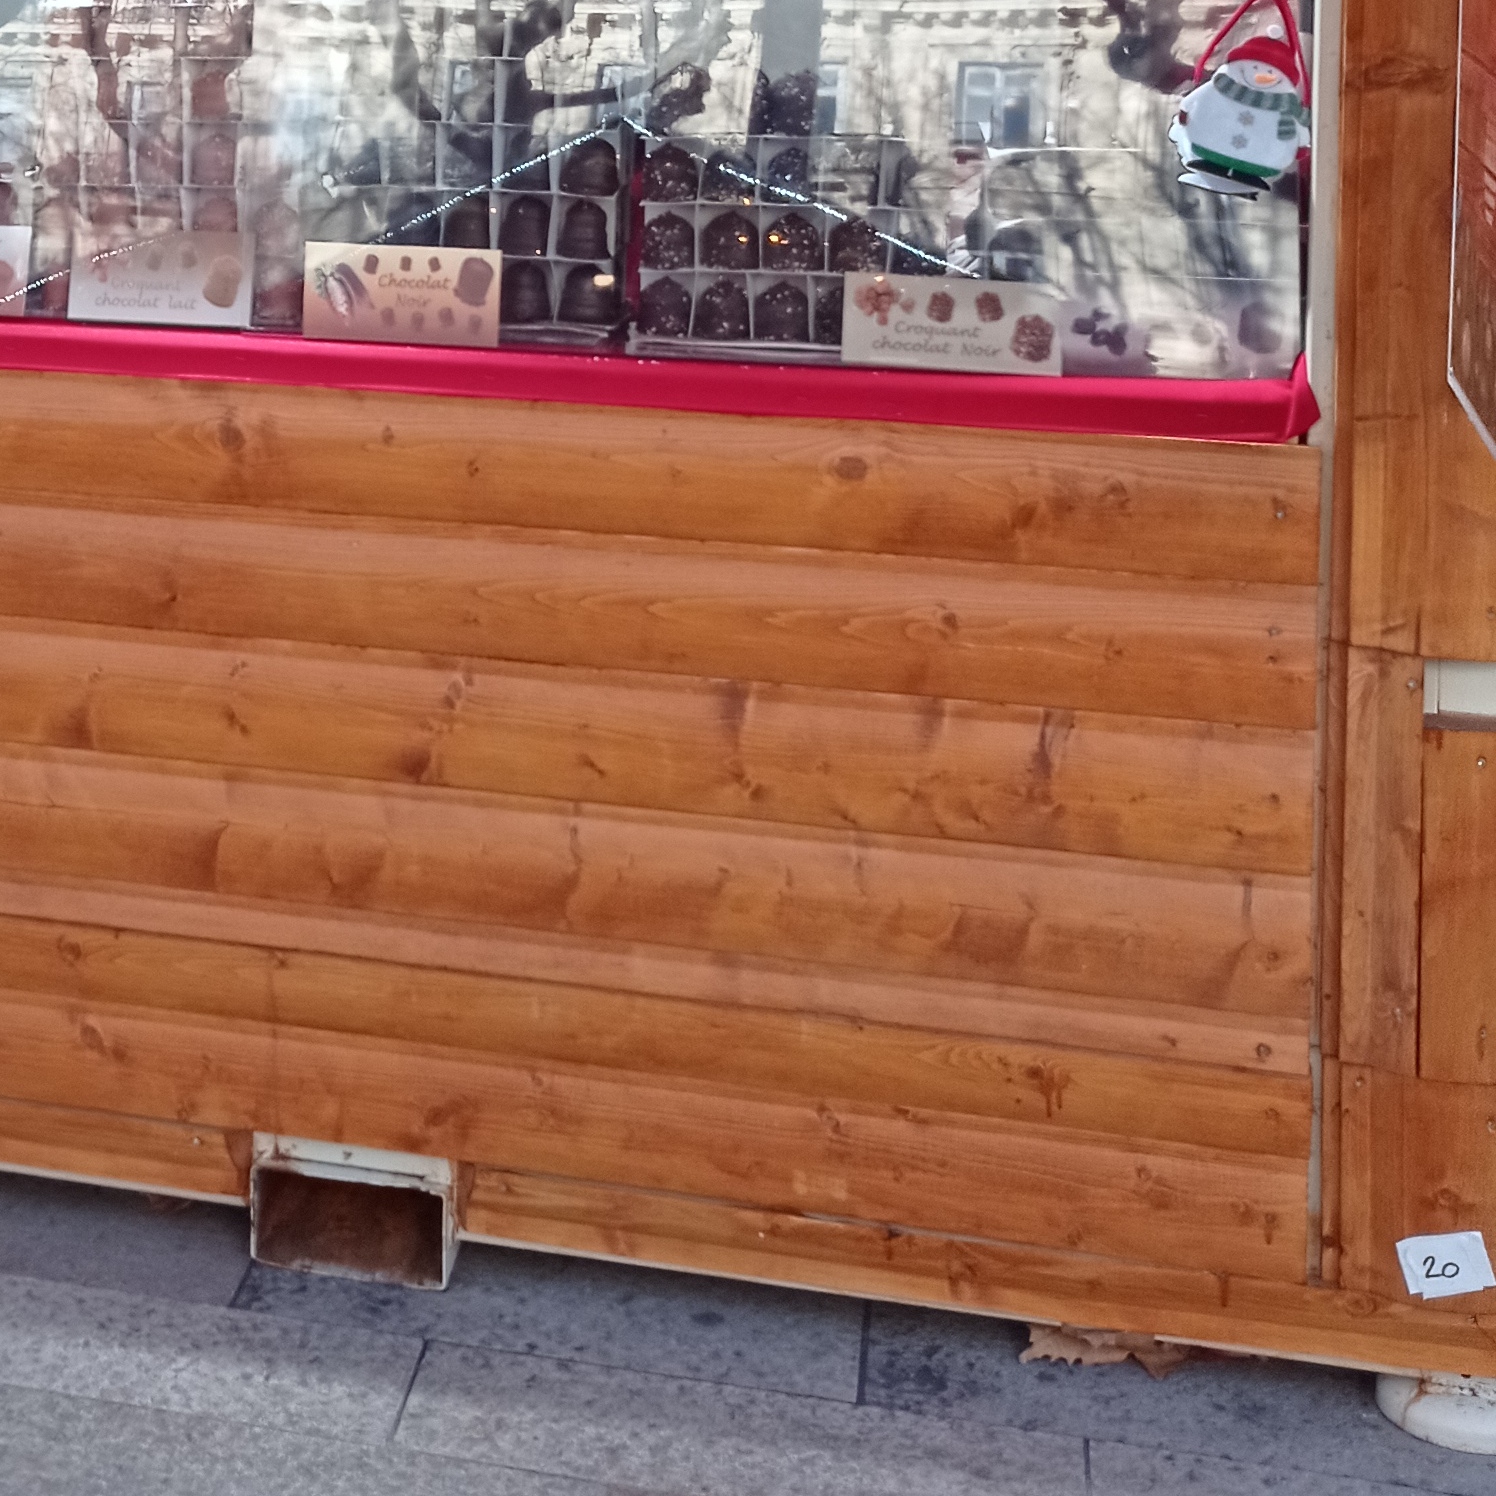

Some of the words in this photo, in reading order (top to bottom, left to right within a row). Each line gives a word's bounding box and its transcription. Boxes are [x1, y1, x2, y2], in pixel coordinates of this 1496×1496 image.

[377, 272, 452, 290] Chocolat
[894, 320, 982, 346] Croquant
[871, 335, 953, 354] chocolat
[1422, 1255, 1460, 1279] 20
